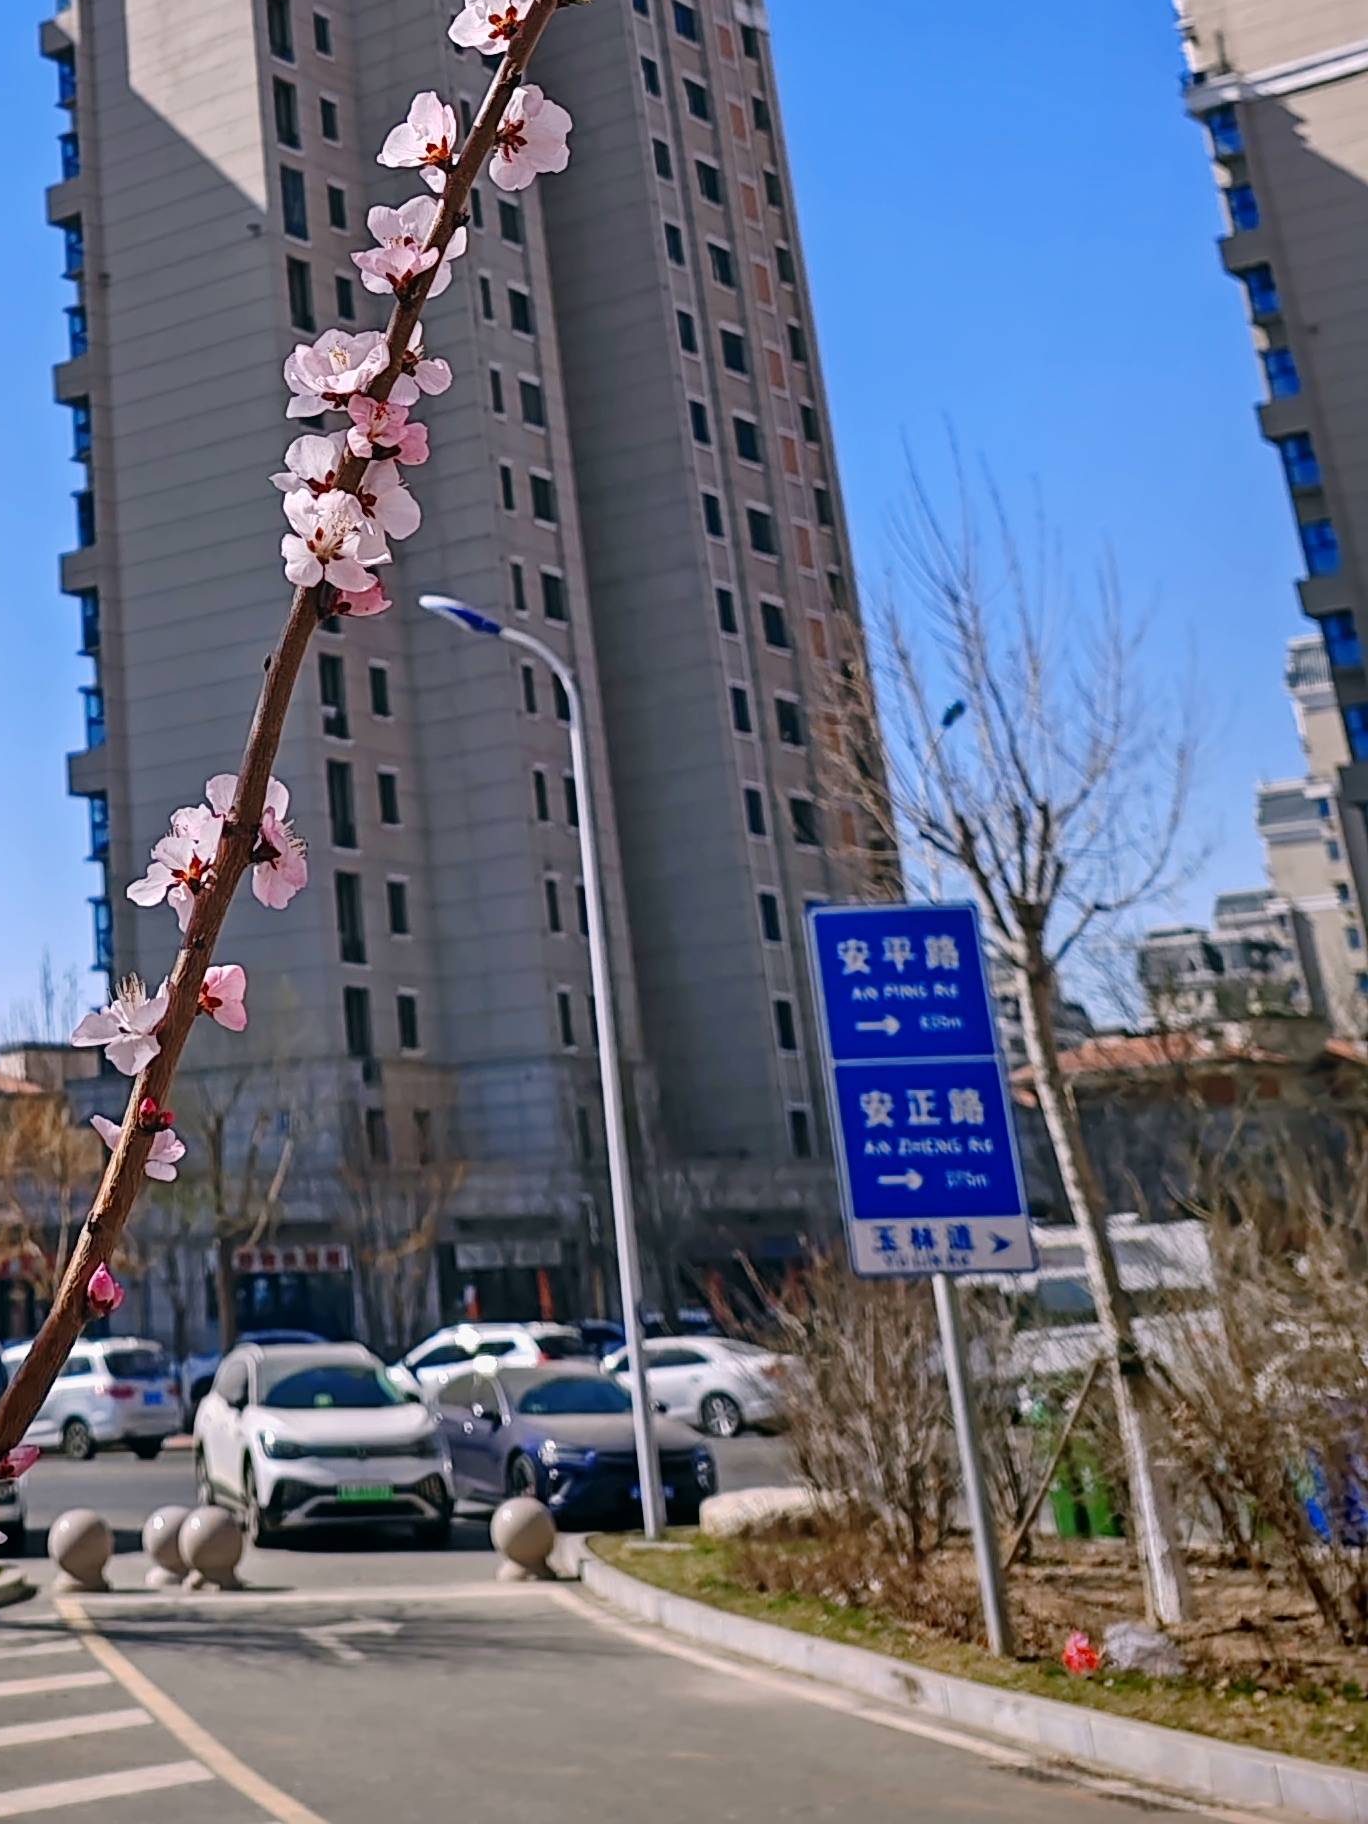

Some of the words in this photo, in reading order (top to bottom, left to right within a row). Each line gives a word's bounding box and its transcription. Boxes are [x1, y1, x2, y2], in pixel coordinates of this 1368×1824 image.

[836, 934, 960, 975] 安平路
[859, 1088, 985, 1127] 安正路
